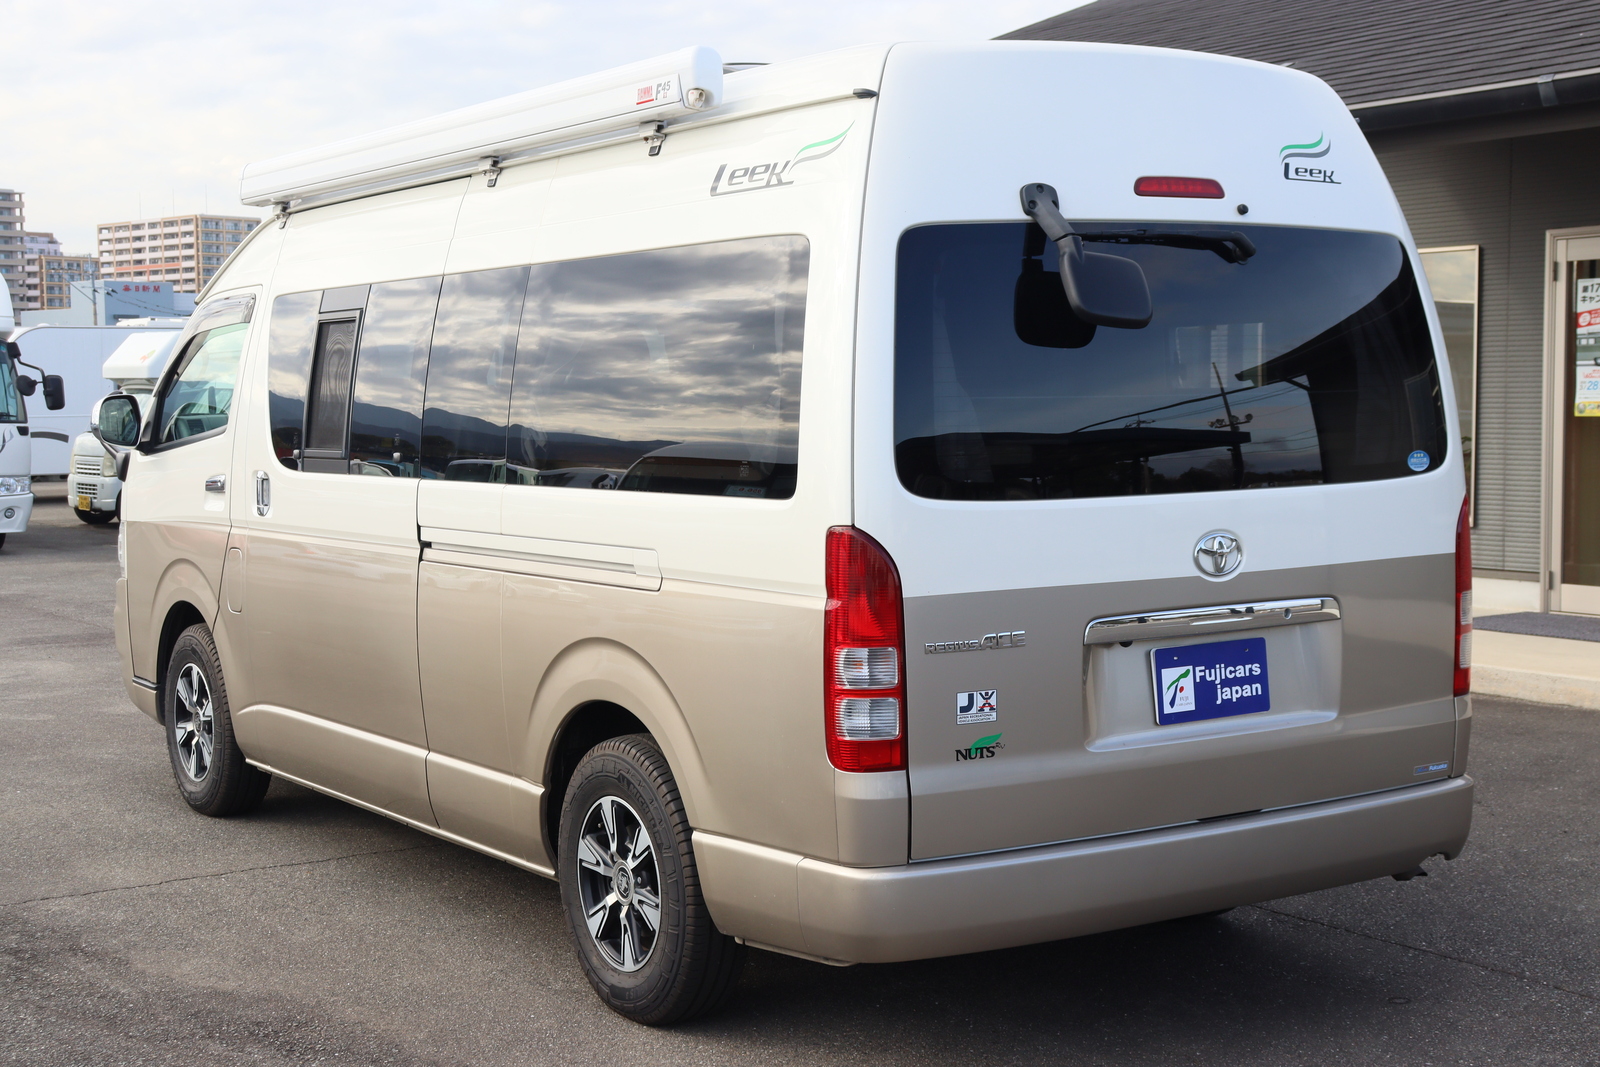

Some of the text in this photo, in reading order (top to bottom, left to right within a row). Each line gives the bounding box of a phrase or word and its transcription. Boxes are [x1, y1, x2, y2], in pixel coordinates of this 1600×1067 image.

[710, 159, 795, 197] Leek
[1283, 162, 1342, 185] Leek
[1195, 663, 1262, 684] Fujicars
[1216, 683, 1262, 705] japan
[955, 746, 996, 762] NUTS
